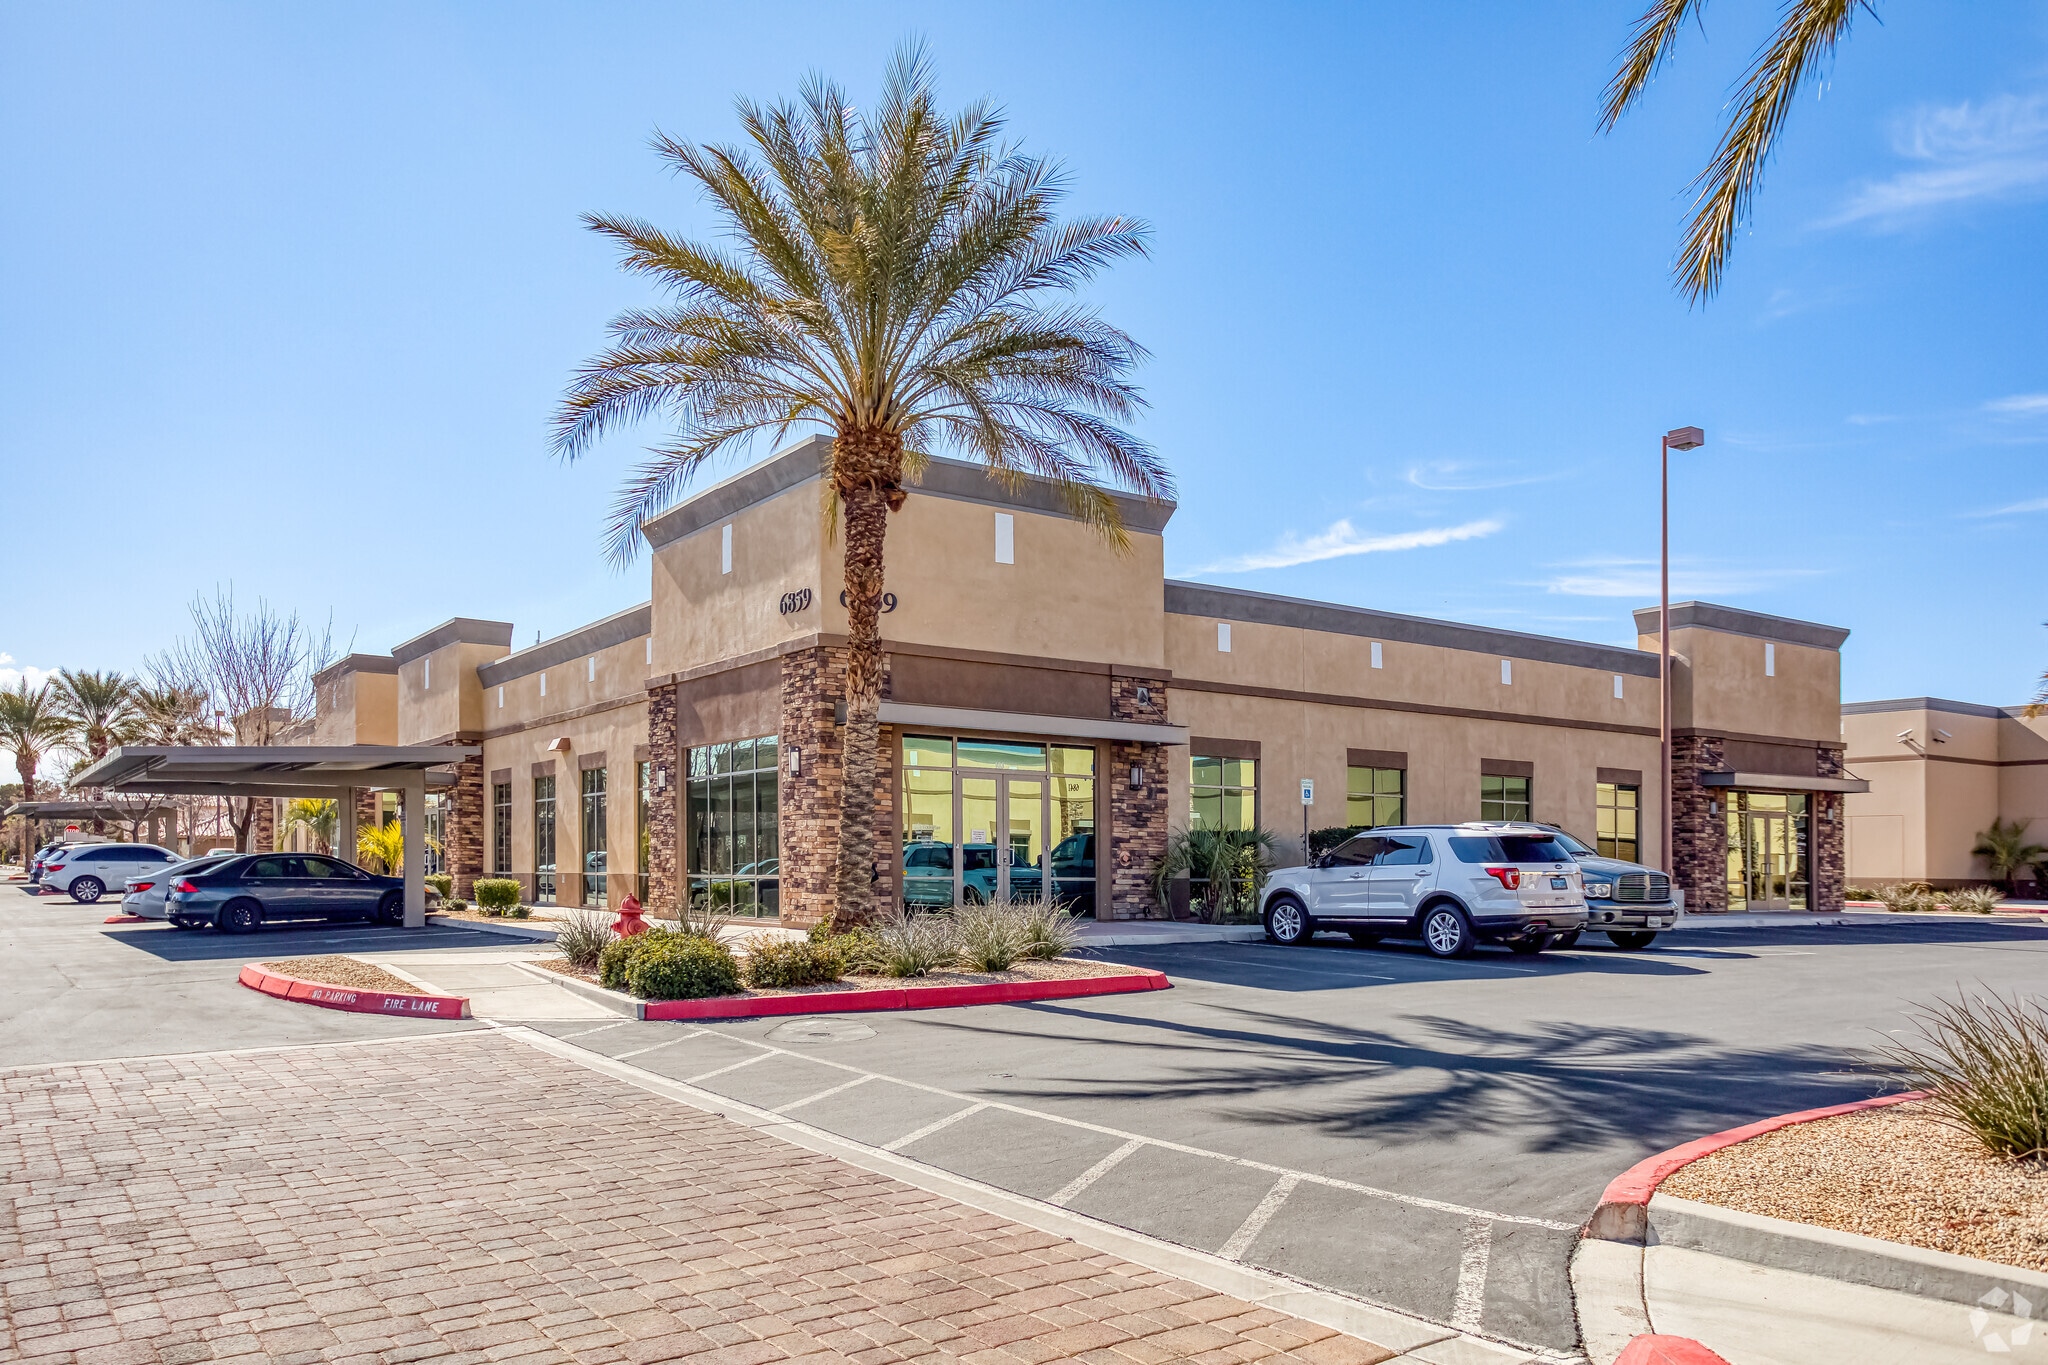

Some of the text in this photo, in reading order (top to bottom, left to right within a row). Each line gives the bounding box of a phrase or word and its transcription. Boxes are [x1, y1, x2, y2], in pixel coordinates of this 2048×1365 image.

[780, 588, 812, 616] 6859
[311, 988, 440, 1013] NO PARKING FIRE LANE
